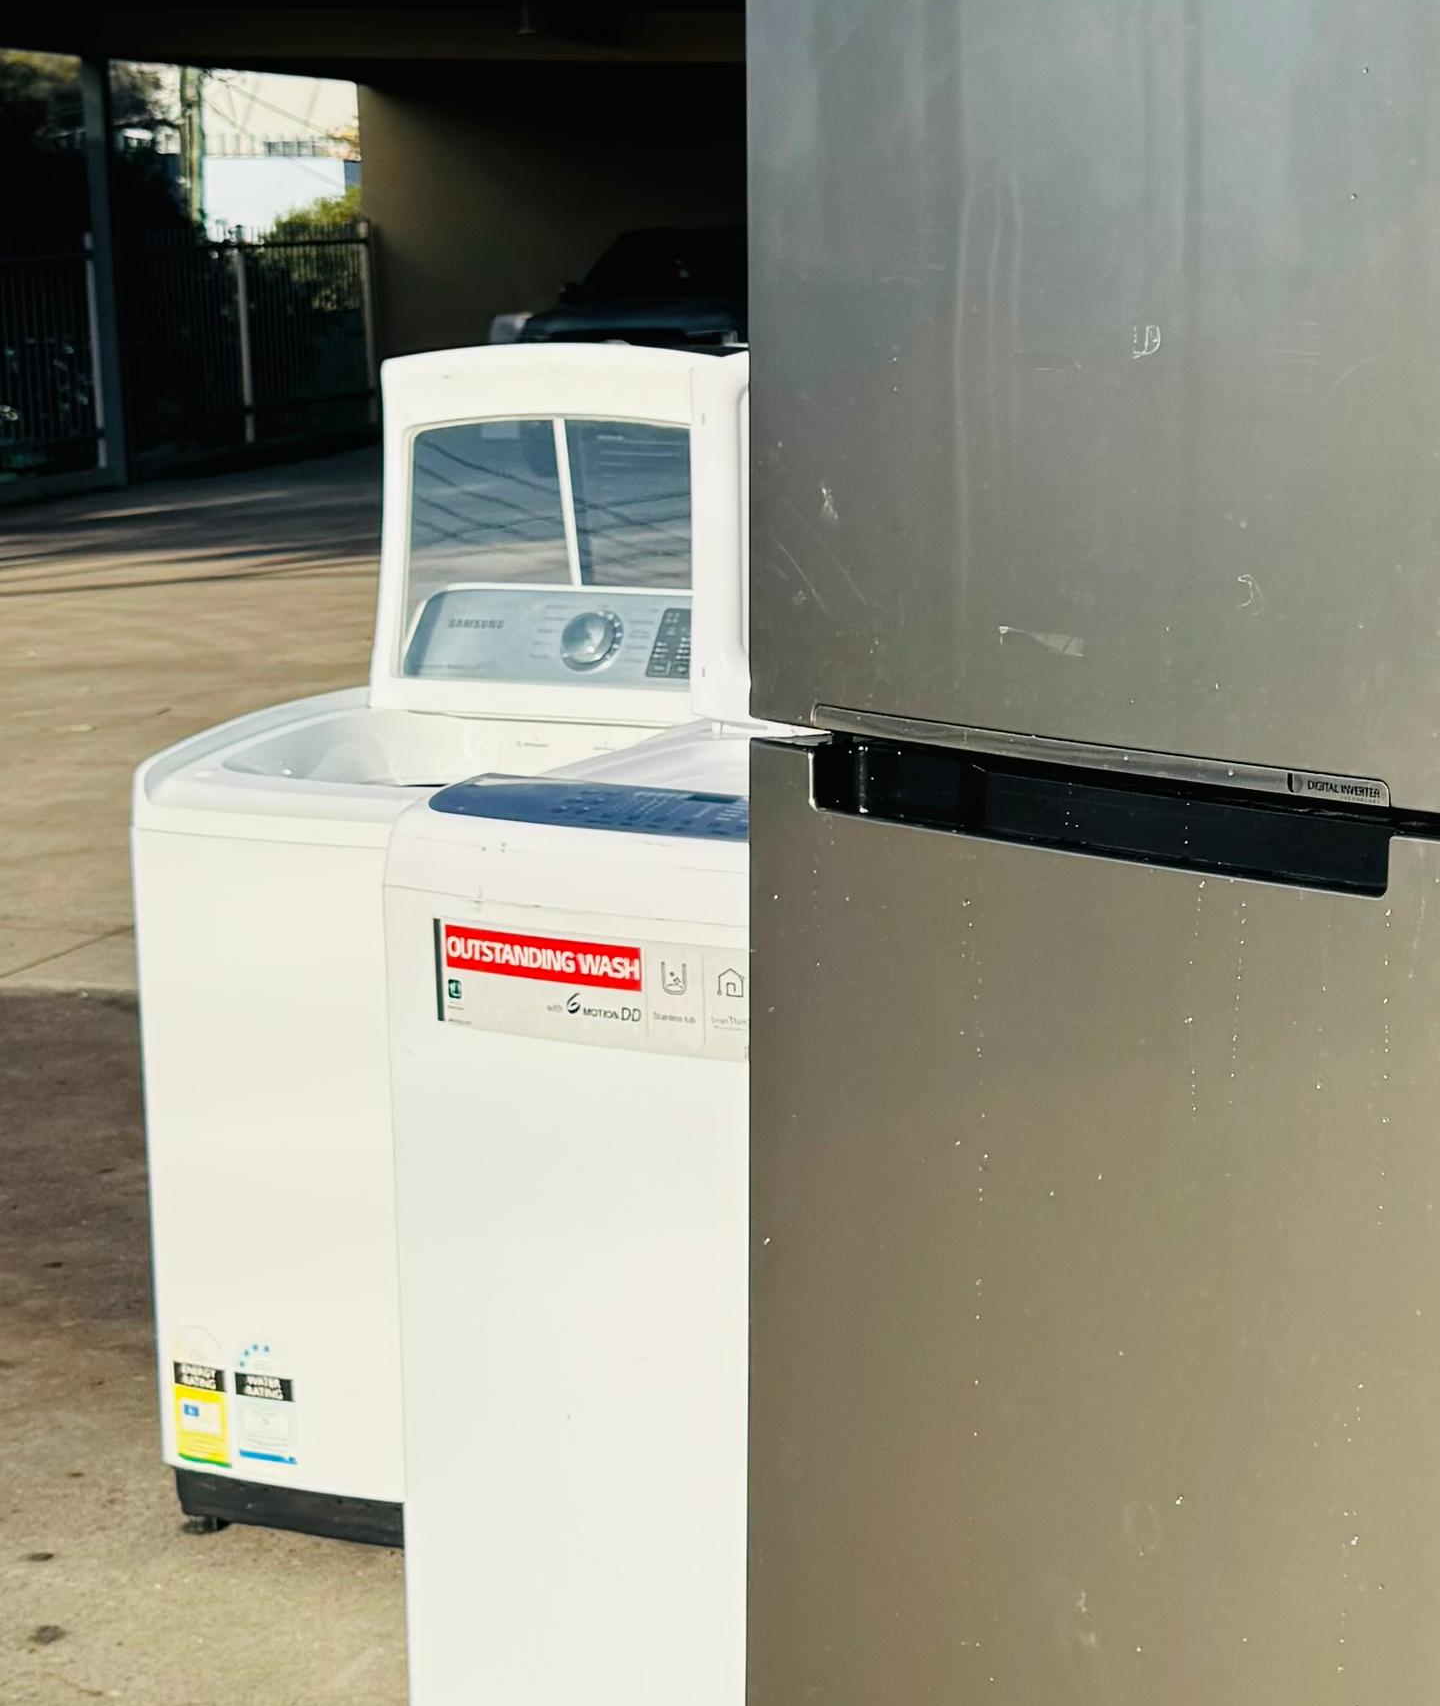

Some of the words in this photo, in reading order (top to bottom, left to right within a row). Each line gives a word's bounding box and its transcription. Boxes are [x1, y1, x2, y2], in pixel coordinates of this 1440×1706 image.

[448, 618, 504, 630] SAMSUNG
[1308, 780, 1340, 793] DIGITAL
[1341, 784, 1380, 798] INVERTER
[447, 936, 576, 974] OUTSTANDING
[577, 953, 640, 980] WASH
[583, 1007, 619, 1019] MOTION
[620, 1007, 642, 1022] DD
